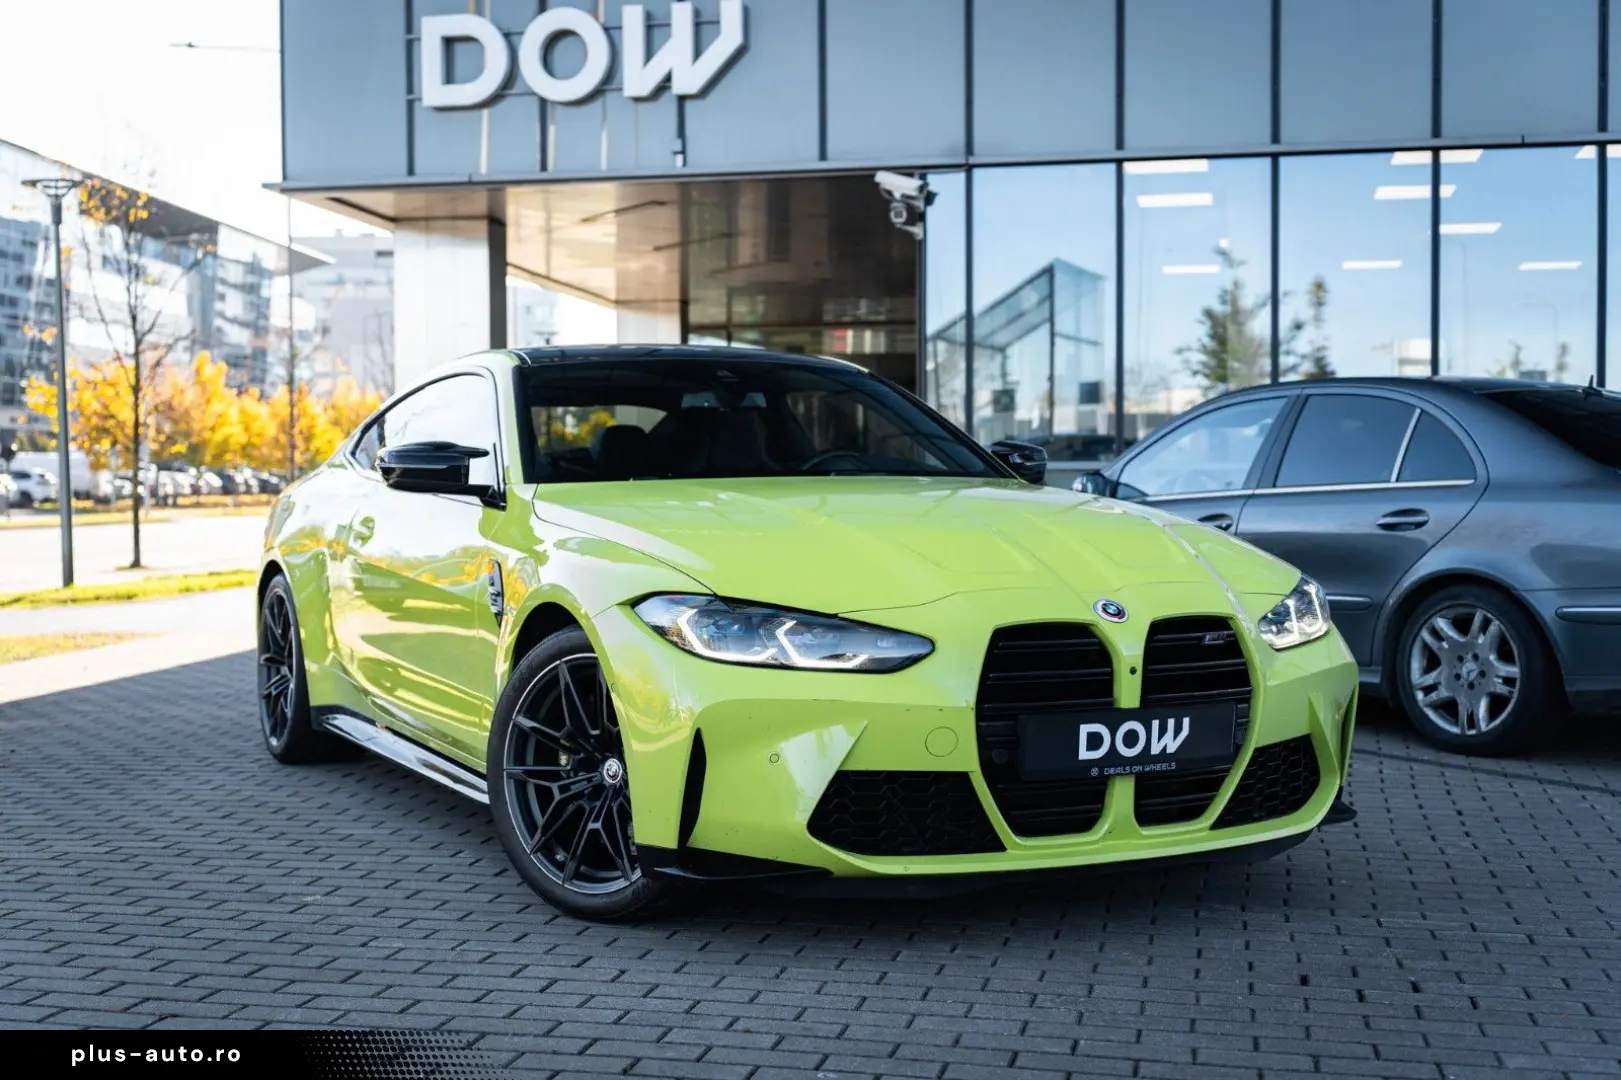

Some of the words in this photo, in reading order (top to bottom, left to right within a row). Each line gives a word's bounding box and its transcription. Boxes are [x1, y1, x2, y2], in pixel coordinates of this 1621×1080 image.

[421, 0, 746, 107] DOW
[1078, 716, 1190, 760] DOW
[1103, 765, 1131, 775] DEALS
[1131, 765, 1143, 773] ON
[1144, 762, 1176, 772] WHEELS
